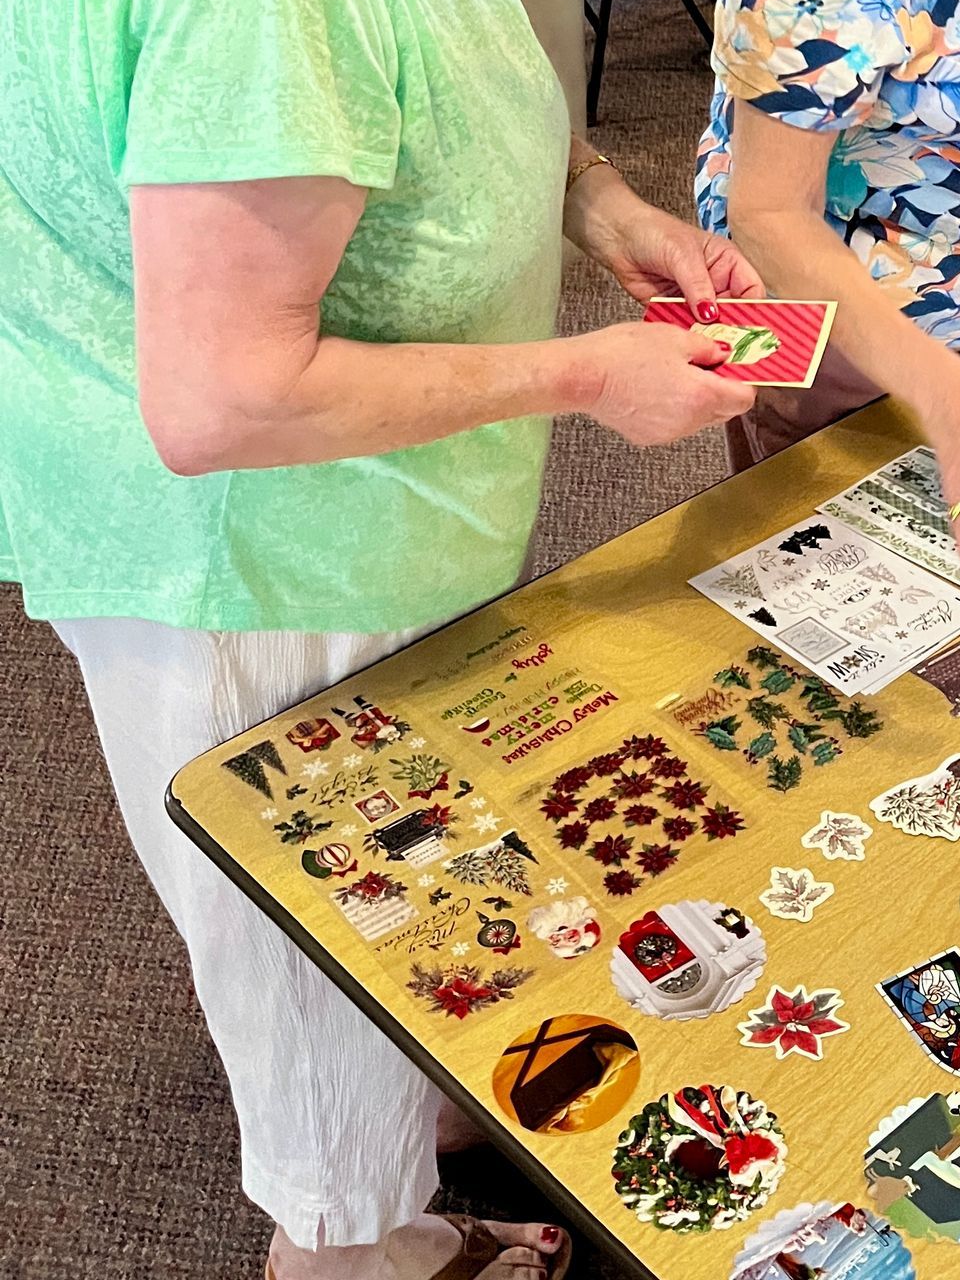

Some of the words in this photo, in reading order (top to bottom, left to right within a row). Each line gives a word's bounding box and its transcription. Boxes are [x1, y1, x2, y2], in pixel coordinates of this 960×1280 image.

[907, 599, 950, 627] Christmas
[915, 611, 952, 632] Merry
[511, 643, 553, 676] jolly
[481, 695, 560, 748] christmas
[573, 691, 619, 724] Merry
[502, 717, 574, 766] Christmas
[506, 712, 557, 747] merry
[371, 898, 472, 951] Christmas
[405, 921, 461, 953] Merry
